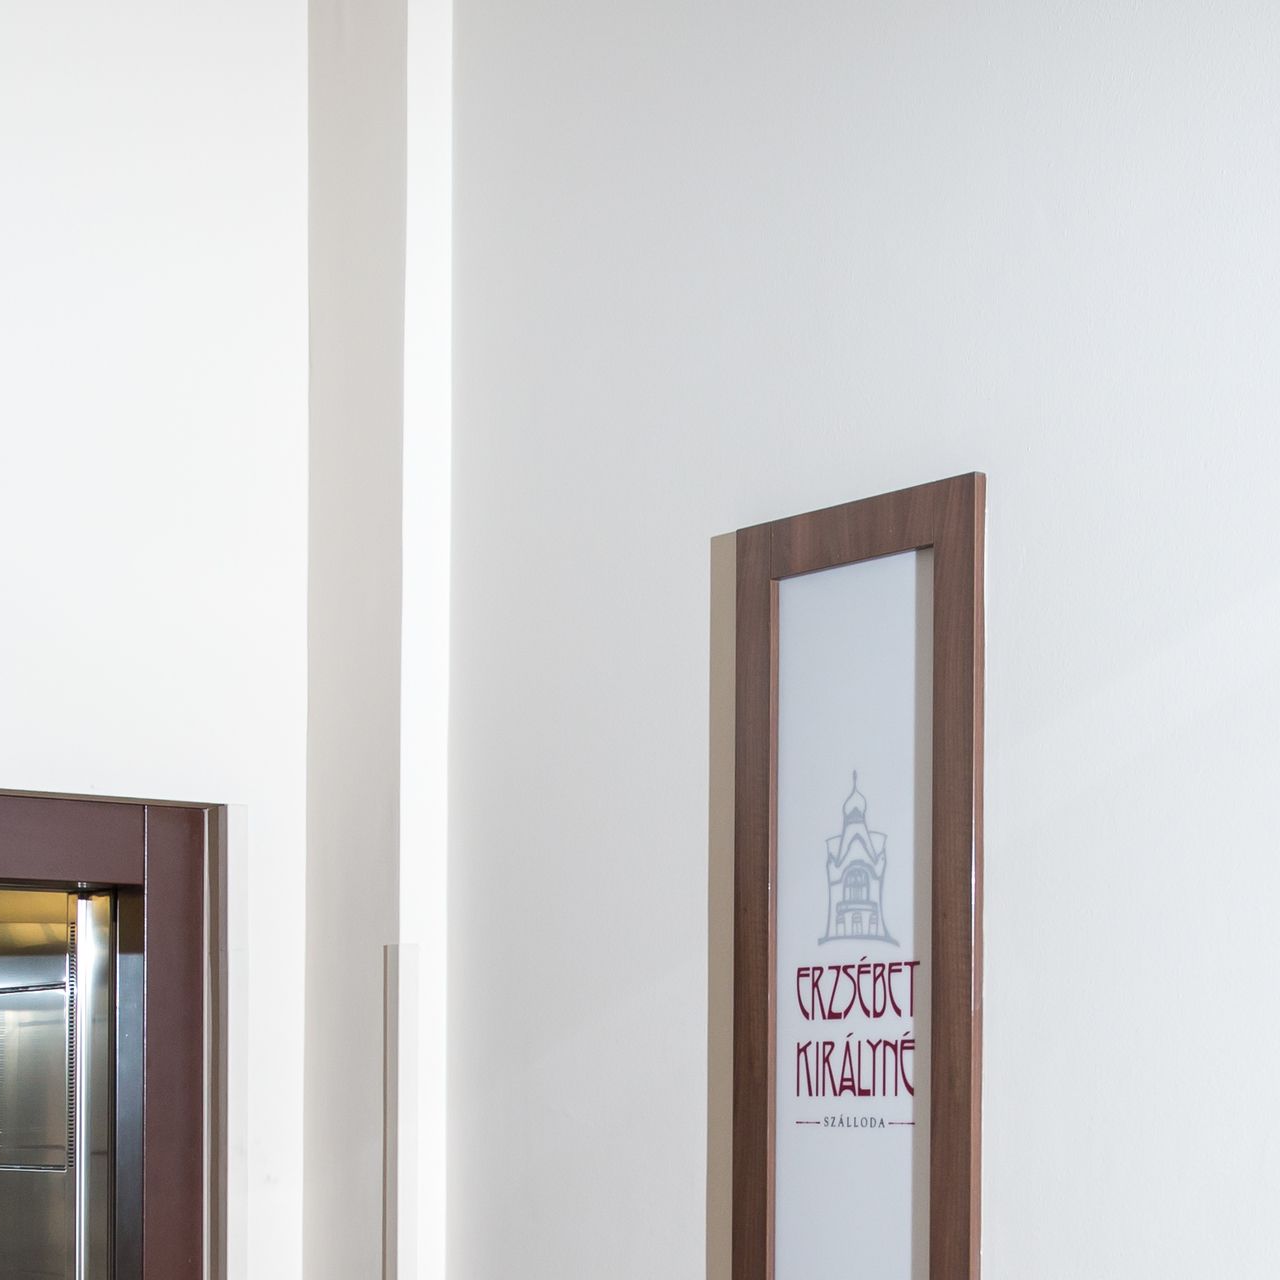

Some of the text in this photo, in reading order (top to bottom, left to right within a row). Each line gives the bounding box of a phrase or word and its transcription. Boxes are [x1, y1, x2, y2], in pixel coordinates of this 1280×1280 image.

[796, 955, 921, 1021] ERZSÉBET
[796, 1030, 916, 1097] KIRÁLYNÉ
[823, 1114, 886, 1129] SZÁLLODA
